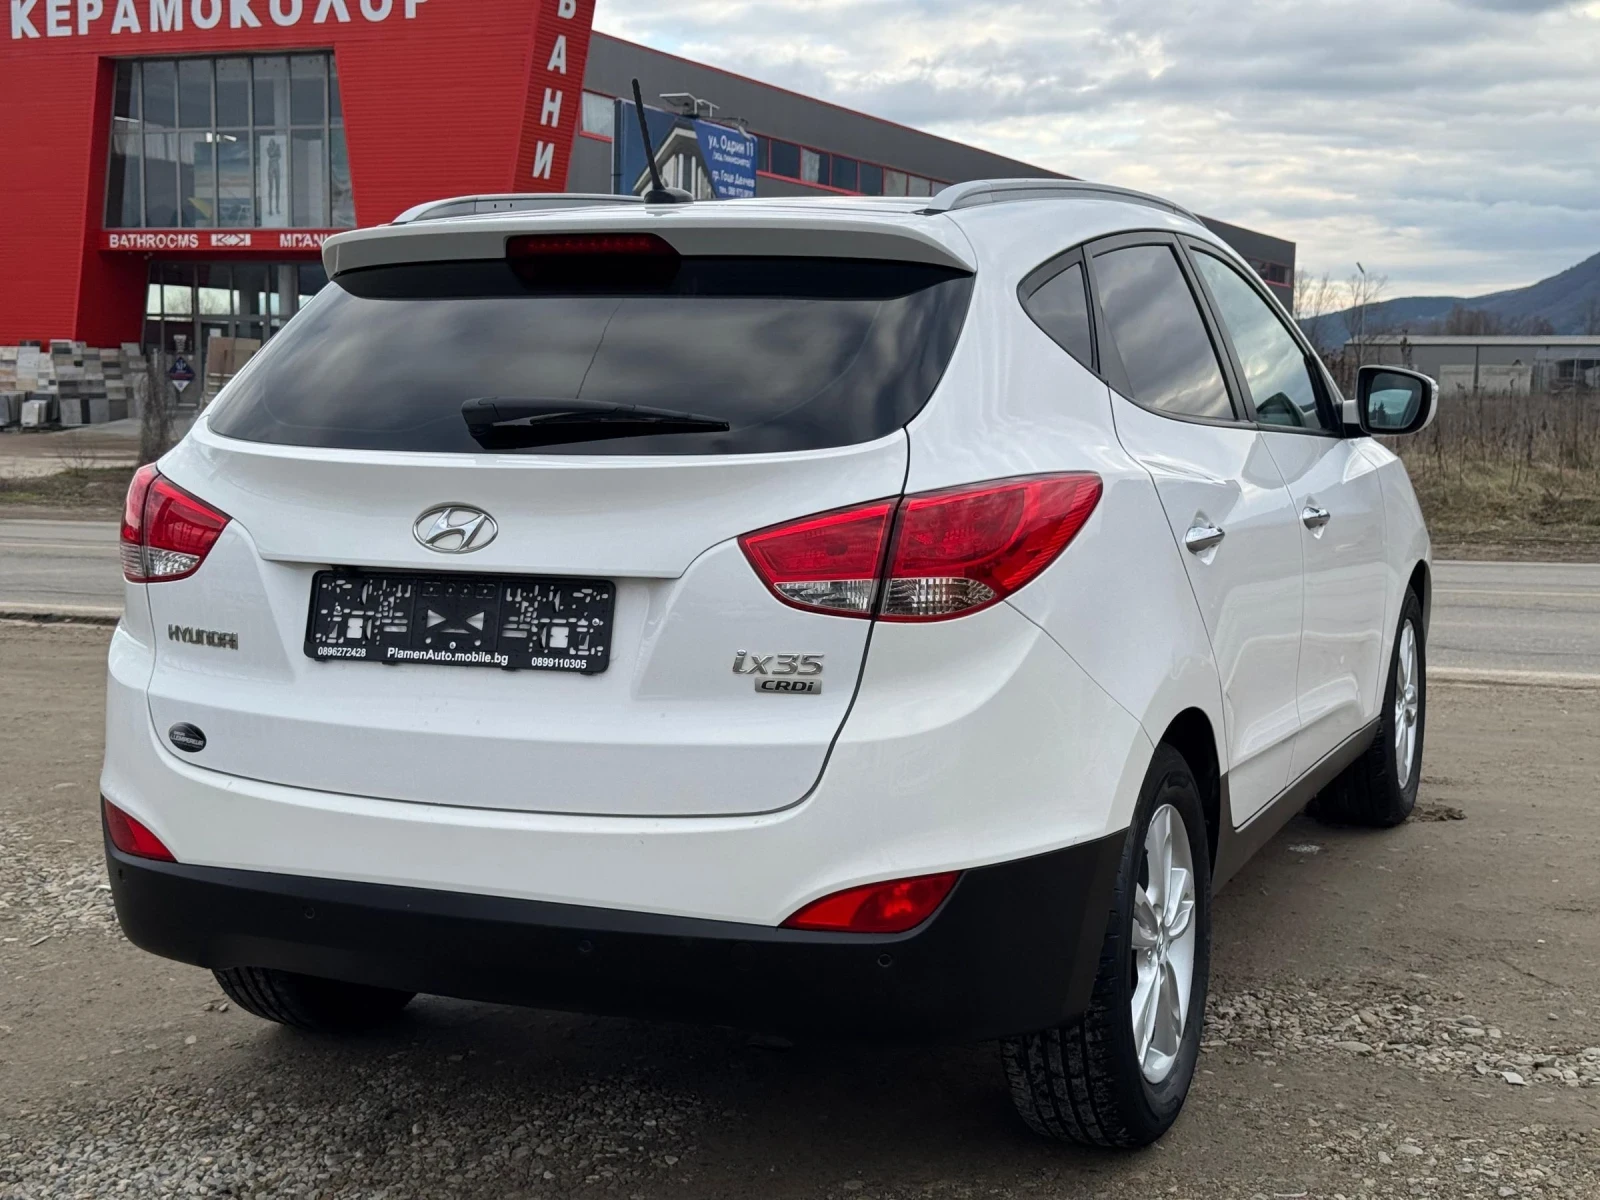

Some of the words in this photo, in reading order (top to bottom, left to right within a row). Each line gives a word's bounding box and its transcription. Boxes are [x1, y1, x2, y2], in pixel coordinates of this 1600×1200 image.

[317, 646, 367, 657] 0896272428
[387, 647, 509, 666] PlamenAuto.mobile.bg
[531, 657, 587, 669] 0899110305
[732, 648, 825, 675] ix35
[761, 680, 815, 692] CRDi
